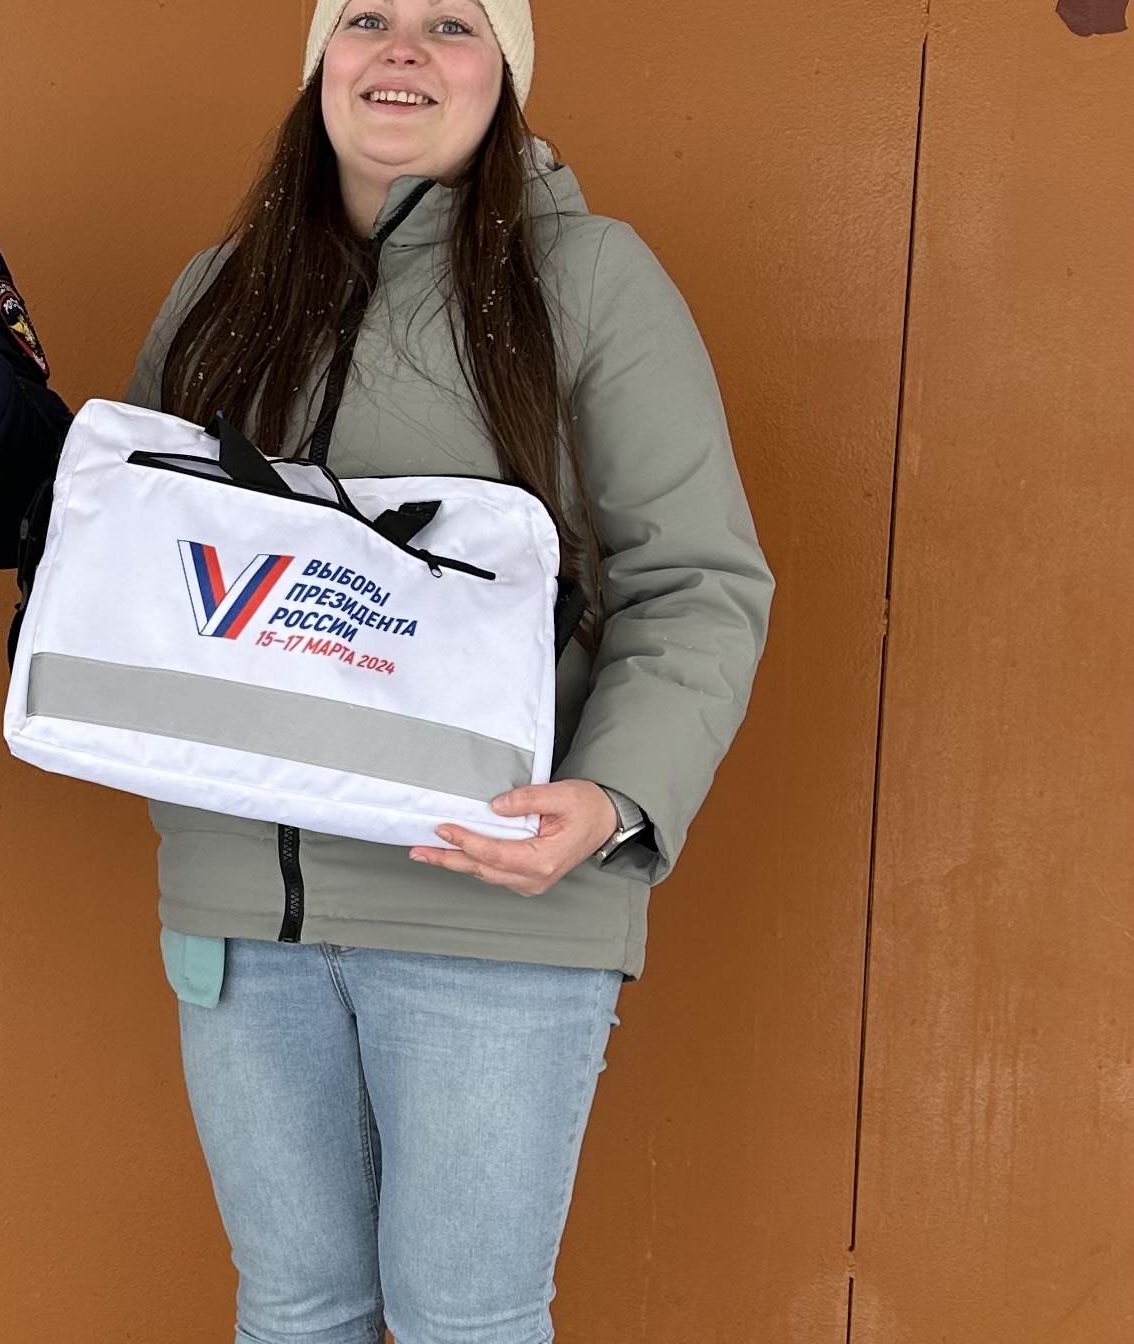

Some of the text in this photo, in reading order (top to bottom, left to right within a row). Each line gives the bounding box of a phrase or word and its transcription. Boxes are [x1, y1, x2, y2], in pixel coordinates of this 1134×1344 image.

[302, 559, 391, 607] ВЫБОРЫ
[268, 607, 359, 643] РОССИИ
[285, 582, 418, 637] ПРЕЗИДЕНТА
[301, 637, 357, 665] МАРТА
[356, 654, 395, 675] 2024
